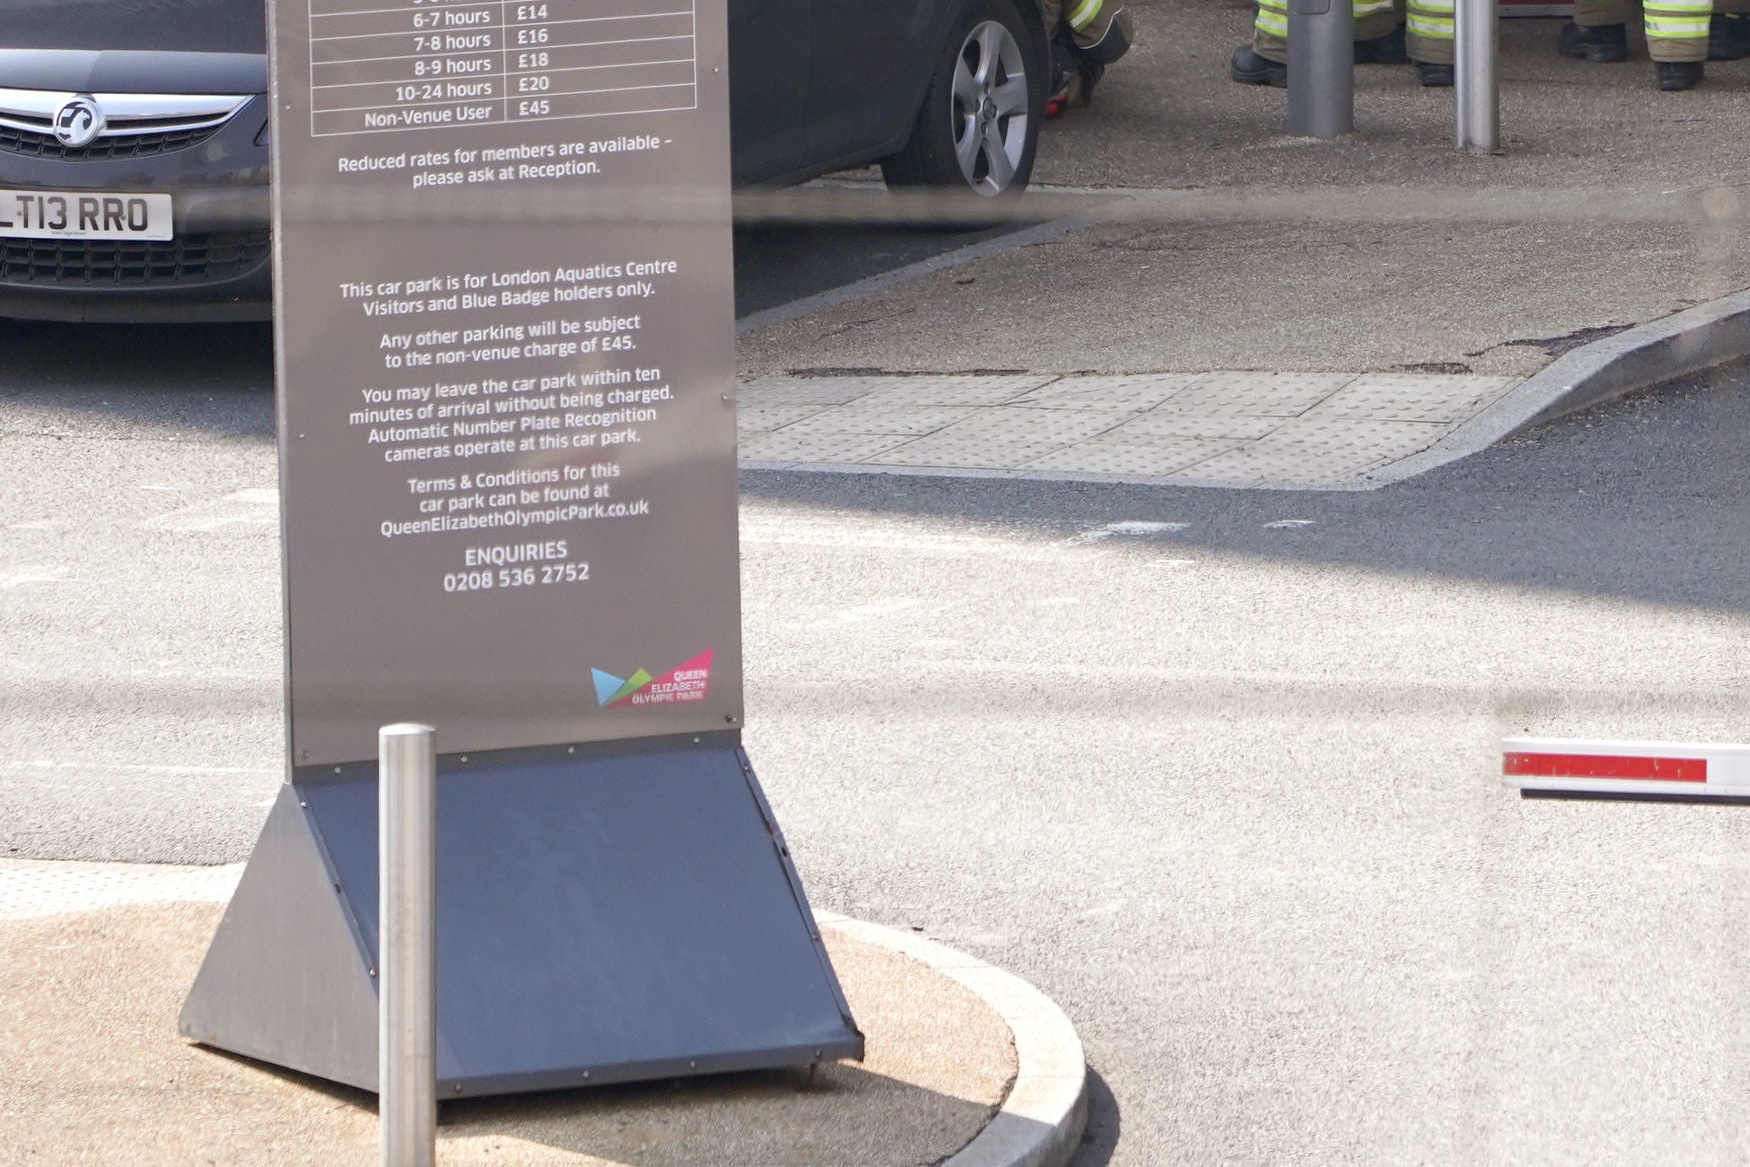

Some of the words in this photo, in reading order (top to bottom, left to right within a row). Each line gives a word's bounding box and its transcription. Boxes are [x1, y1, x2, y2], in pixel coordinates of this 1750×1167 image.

[413, 12, 440, 28] 6-7
[445, 11, 490, 25] hours
[517, 4, 548, 20] £14
[414, 36, 441, 51] 7-8
[446, 34, 491, 49] hours
[518, 28, 548, 44] £16
[414, 60, 442, 76] 8-9
[446, 59, 491, 73] hours
[518, 52, 548, 68] £18
[396, 84, 442, 101] 10-24
[447, 83, 492, 97] hours
[519, 76, 549, 92] £20
[365, 110, 452, 127] Non-Venue
[456, 106, 492, 121] User
[519, 100, 550, 116] £45
[338, 152, 406, 172] Reduced
[410, 152, 450, 167] rates
[454, 148, 478, 164] for
[482, 144, 555, 162] members
[559, 142, 585, 156] are
[589, 134, 660, 153] available
[413, 172, 464, 189] please
[468, 167, 494, 183] ask
[498, 166, 514, 180] at
[519, 160, 600, 179] Reception.
[79, 197, 148, 232] RRO
[339, 282, 373, 298] This
[377, 282, 402, 295] car
[406, 276, 442, 295] park
[447, 275, 460, 290] is
[464, 274, 488, 288] for
[492, 270, 550, 286] London
[554, 264, 622, 283] Aquatics
[626, 260, 677, 276] Centre
[363, 300, 424, 316] Visitors
[428, 295, 457, 312] and
[462, 294, 497, 309] Blue
[502, 290, 550, 306] Badge
[554, 285, 613, 302] holders
[616, 281, 655, 298] only.
[380, 334, 412, 350] Any
[416, 330, 459, 346] other
[463, 324, 524, 344] parking
[528, 320, 556, 337] will
[560, 320, 580, 334] be
[584, 315, 640, 333] subject
[385, 354, 402, 368] to
[405, 351, 432, 366] the
[436, 346, 520, 364] non-venue
[524, 342, 577, 357] charge
[581, 337, 598, 353] of
[601, 335, 636, 351] £45.
[362, 388, 392, 403] You
[396, 387, 431, 402] may
[435, 383, 478, 398] leave
[482, 378, 508, 394] the
[512, 378, 537, 392] car
[540, 372, 576, 392] park
[580, 368, 631, 386] within
[635, 368, 660, 382] ten
[350, 407, 413, 425] minutes
[417, 403, 434, 419] of
[438, 399, 490, 418] arrival
[495, 395, 556, 413] without
[560, 393, 604, 413] being
[607, 386, 674, 408] charged.
[368, 423, 449, 444] Automatic
[453, 419, 516, 436] Number
[521, 416, 560, 431] Plate
[565, 407, 656, 427] Recognition
[385, 445, 451, 462] cameras
[454, 439, 516, 458] operate
[519, 436, 535, 451] at
[539, 434, 568, 450] this
[572, 434, 597, 447] car
[601, 428, 641, 447] park.
[407, 478, 456, 494] Terms
[460, 474, 472, 489] &
[476, 469, 559, 488] Conditions
[563, 465, 586, 480] for
[590, 462, 620, 478] this
[420, 499, 444, 512] car
[448, 493, 484, 512] park
[489, 493, 516, 507] can
[520, 489, 540, 504] be
[544, 485, 589, 502] found
[594, 484, 609, 500] at
[381, 500, 649, 537] QueenElizabethOlympicPark.co.uk
[465, 540, 567, 566] ENQUIRIES
[444, 571, 493, 592] 0208
[499, 567, 535, 587] 536
[541, 563, 589, 584] 2752
[651, 681, 705, 693] ELIZABETH
[674, 669, 707, 682] QUEEN
